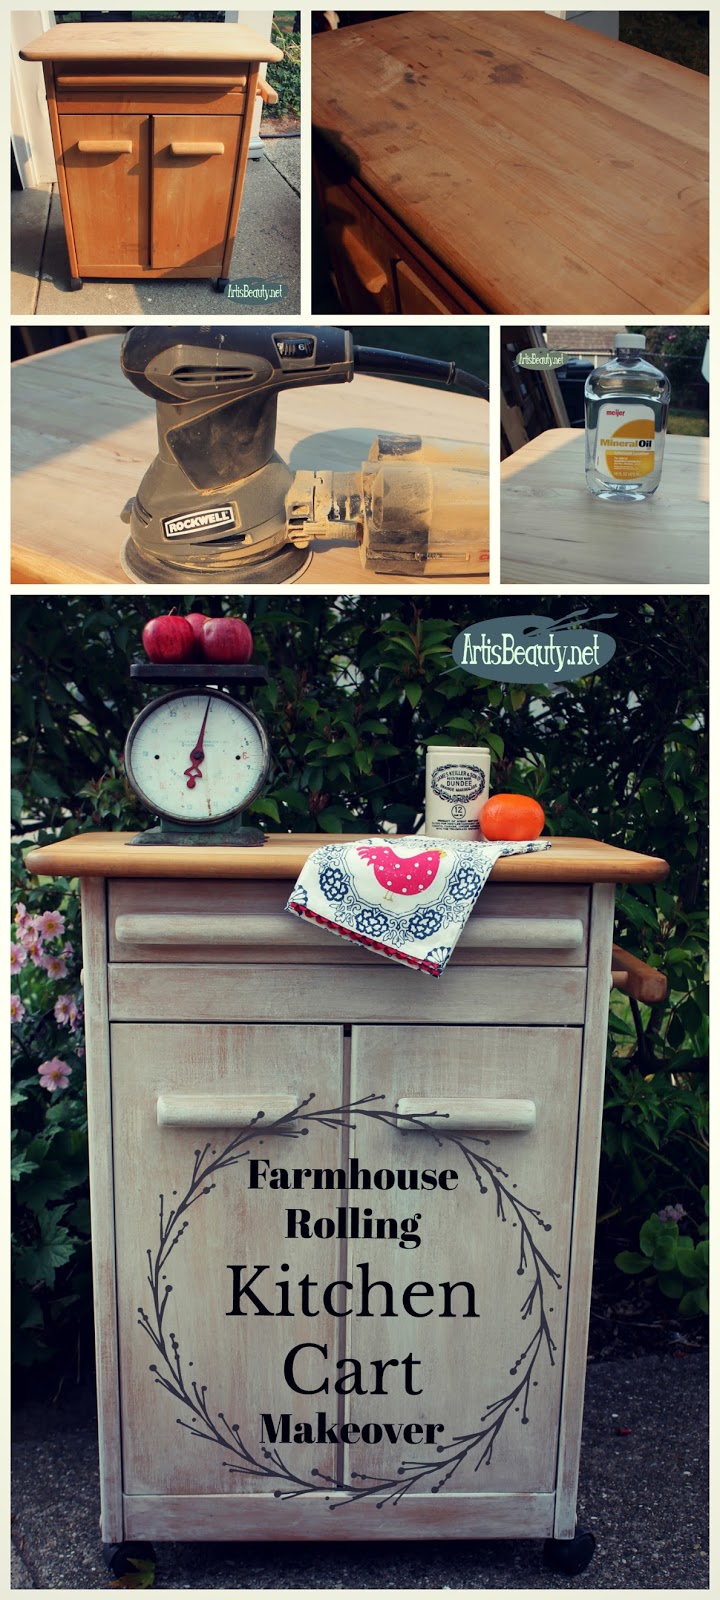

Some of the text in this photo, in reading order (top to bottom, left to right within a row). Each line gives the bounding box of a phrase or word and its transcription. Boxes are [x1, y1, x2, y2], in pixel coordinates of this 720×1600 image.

[298, 343, 305, 351] 6
[606, 409, 625, 417] meijer
[600, 438, 652, 448] Mineral Oil
[169, 511, 230, 533] ROCKWELL
[455, 806, 463, 814] 12
